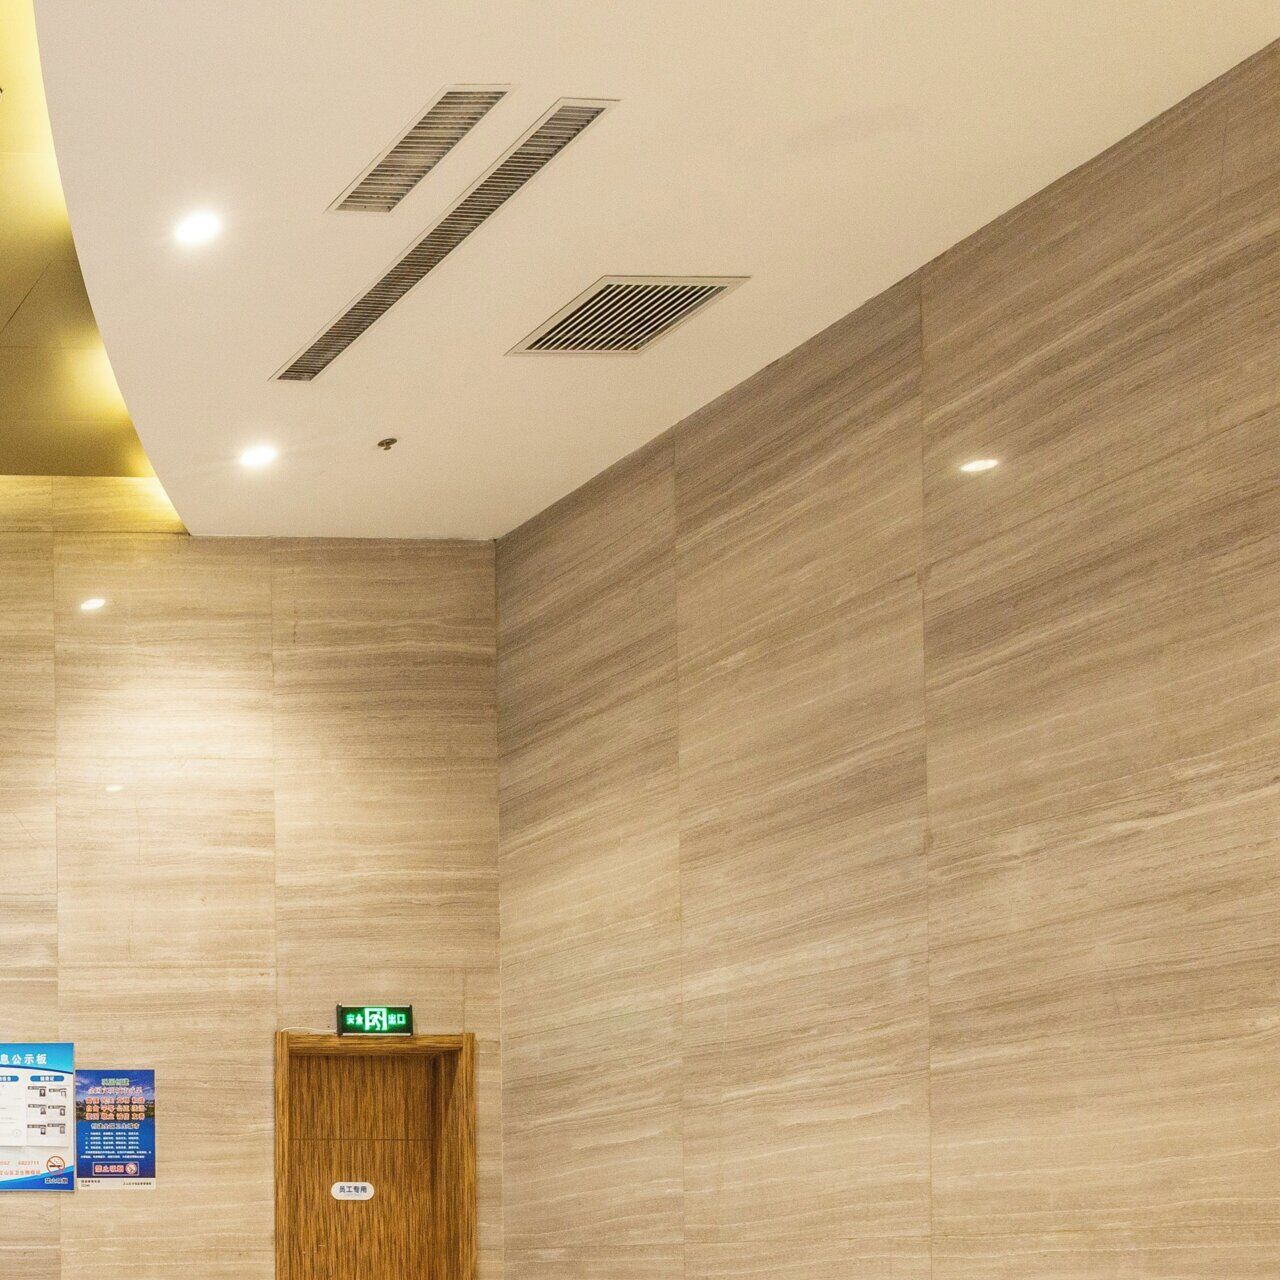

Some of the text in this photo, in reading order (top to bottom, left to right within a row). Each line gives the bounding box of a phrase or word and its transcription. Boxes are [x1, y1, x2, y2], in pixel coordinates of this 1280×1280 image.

[346, 1013, 406, 1025] 安全 出口
[340, 1185, 367, 1193] 员工专用
